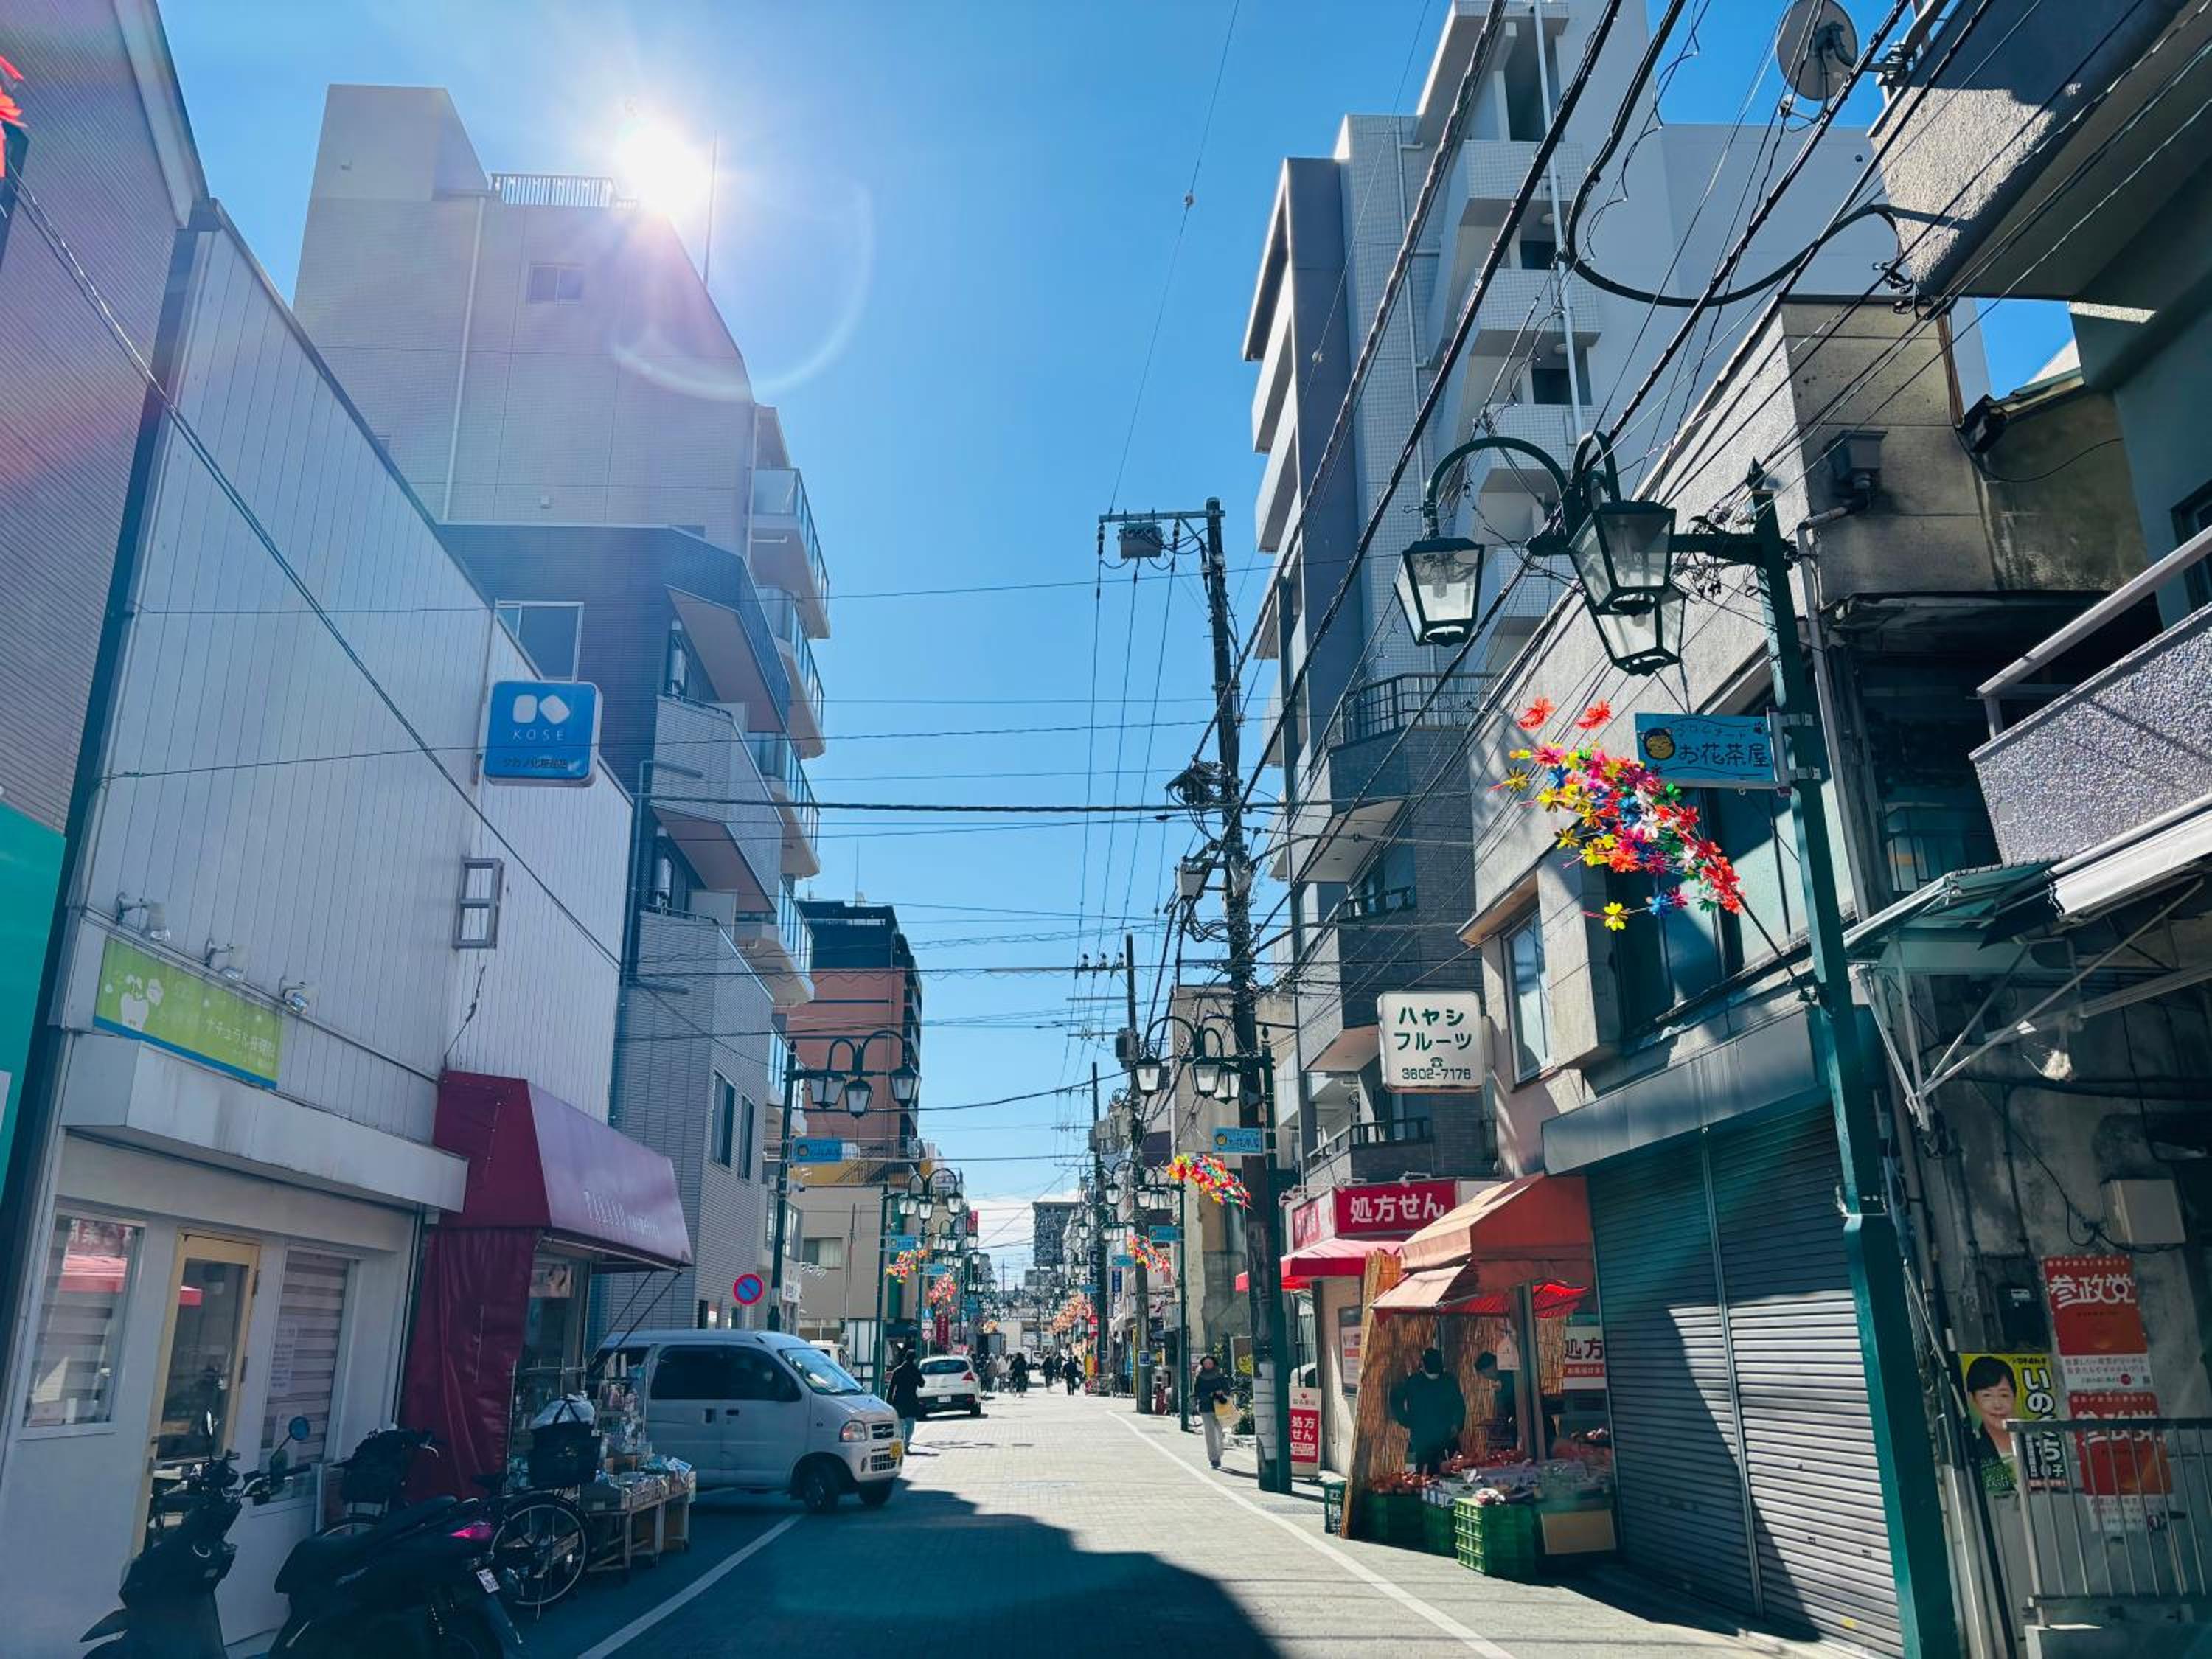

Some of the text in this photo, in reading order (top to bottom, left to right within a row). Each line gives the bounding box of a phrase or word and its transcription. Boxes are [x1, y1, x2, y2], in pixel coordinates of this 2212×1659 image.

[1677, 742, 1770, 768] お花茶屋
[1399, 1006, 1464, 1027] ハヤシ
[1393, 1032, 1472, 1051] フルーツ
[1349, 1192, 1444, 1224] 処方せん
[2049, 1273, 2136, 1310] 参政党
